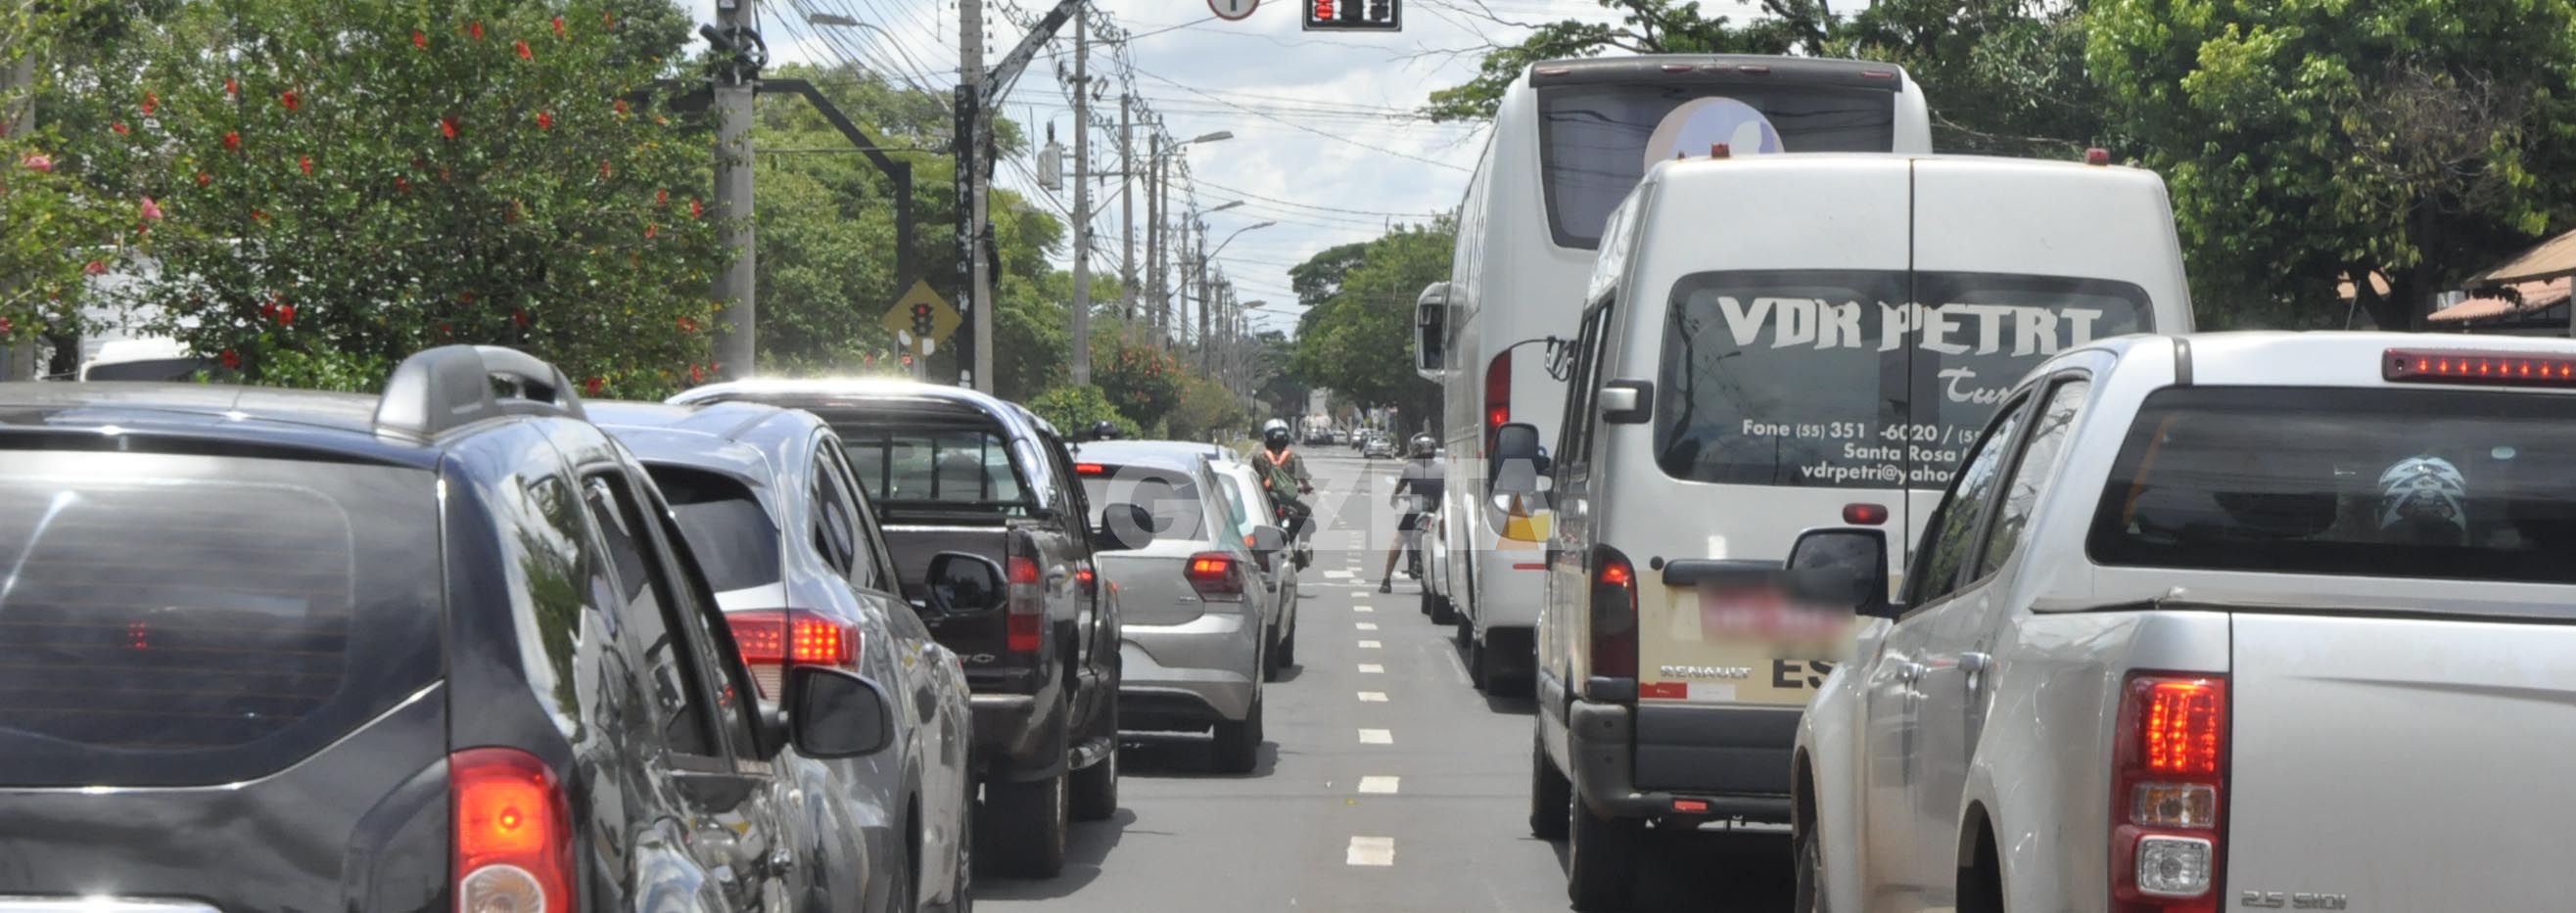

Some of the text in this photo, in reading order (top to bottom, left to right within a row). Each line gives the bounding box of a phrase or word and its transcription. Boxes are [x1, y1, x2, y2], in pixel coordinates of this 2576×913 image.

[1717, 297, 1862, 349] VDR
[1743, 419, 1791, 436] Fone
[1796, 423, 1826, 439] (55)
[1844, 443, 1901, 460] Santa
[1909, 445, 1956, 462] Rosa
[1660, 665, 1753, 679] RENAULT
